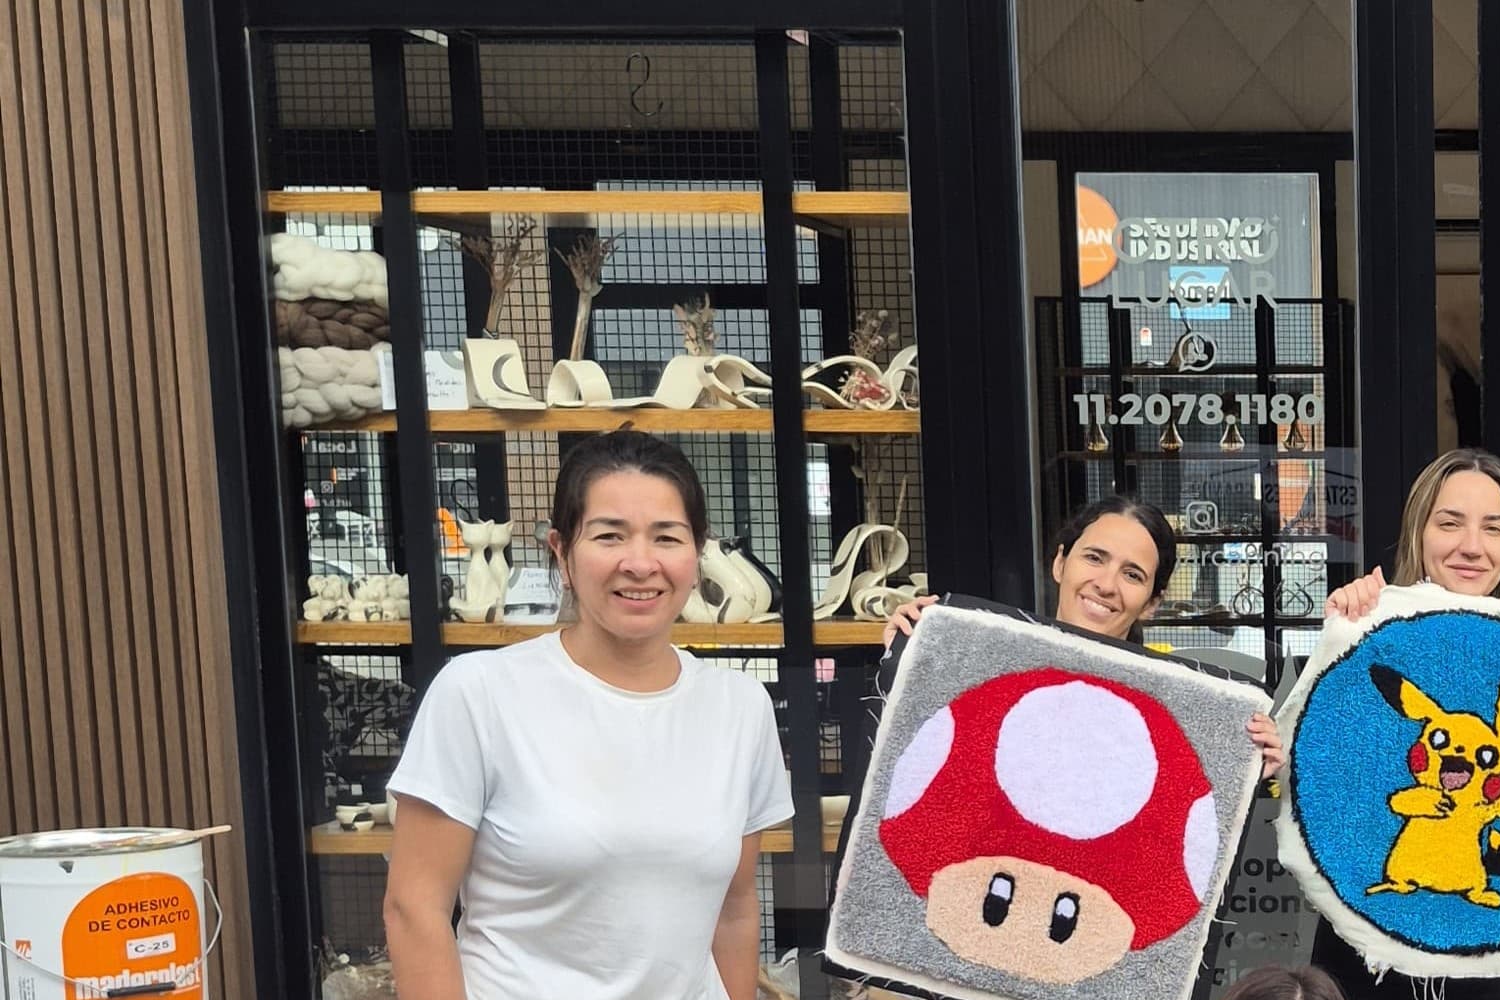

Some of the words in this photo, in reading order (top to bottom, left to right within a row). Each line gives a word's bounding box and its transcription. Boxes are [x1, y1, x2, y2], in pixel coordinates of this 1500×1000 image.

[1112, 217, 1280, 265] OTRO
[1130, 239, 1265, 261] INDUSTRIAL
[1112, 270, 1279, 310] LUGAR
[1073, 393, 1325, 426] 11.2078.1180
[104, 896, 180, 916] ADHESIVO
[88, 919, 112, 933] DE
[116, 909, 191, 931] CONTACTO
[133, 940, 170, 954] C-25
